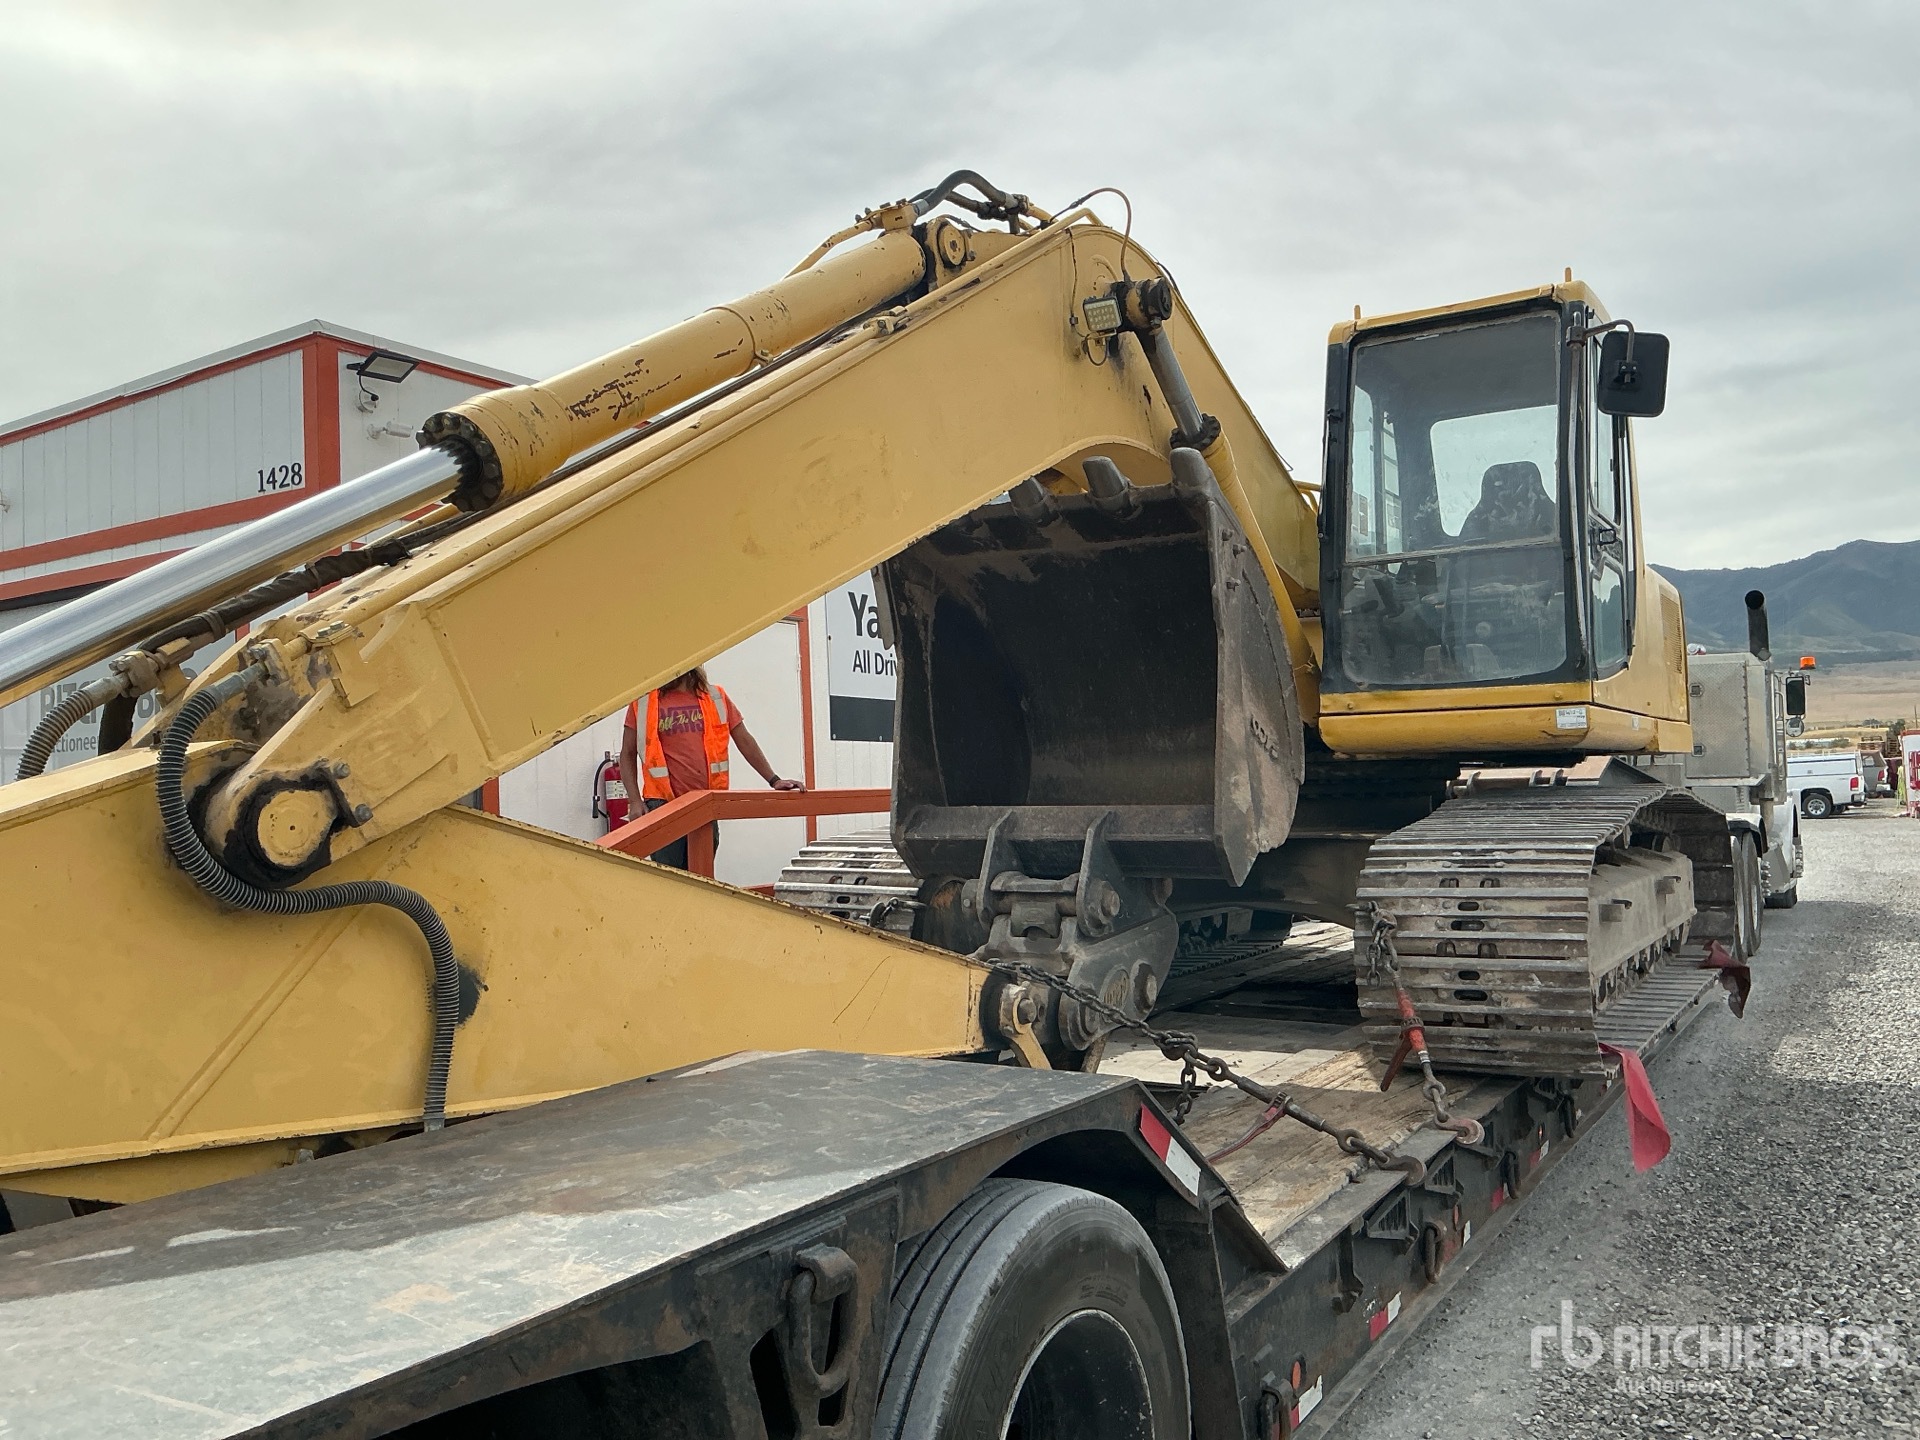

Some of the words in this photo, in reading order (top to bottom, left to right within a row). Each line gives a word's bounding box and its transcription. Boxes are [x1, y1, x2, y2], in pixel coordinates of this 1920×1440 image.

[257, 462, 303, 492] 1428
[848, 591, 882, 639] Ya
[852, 649, 871, 674] All
[51, 733, 99, 754] ctionee
